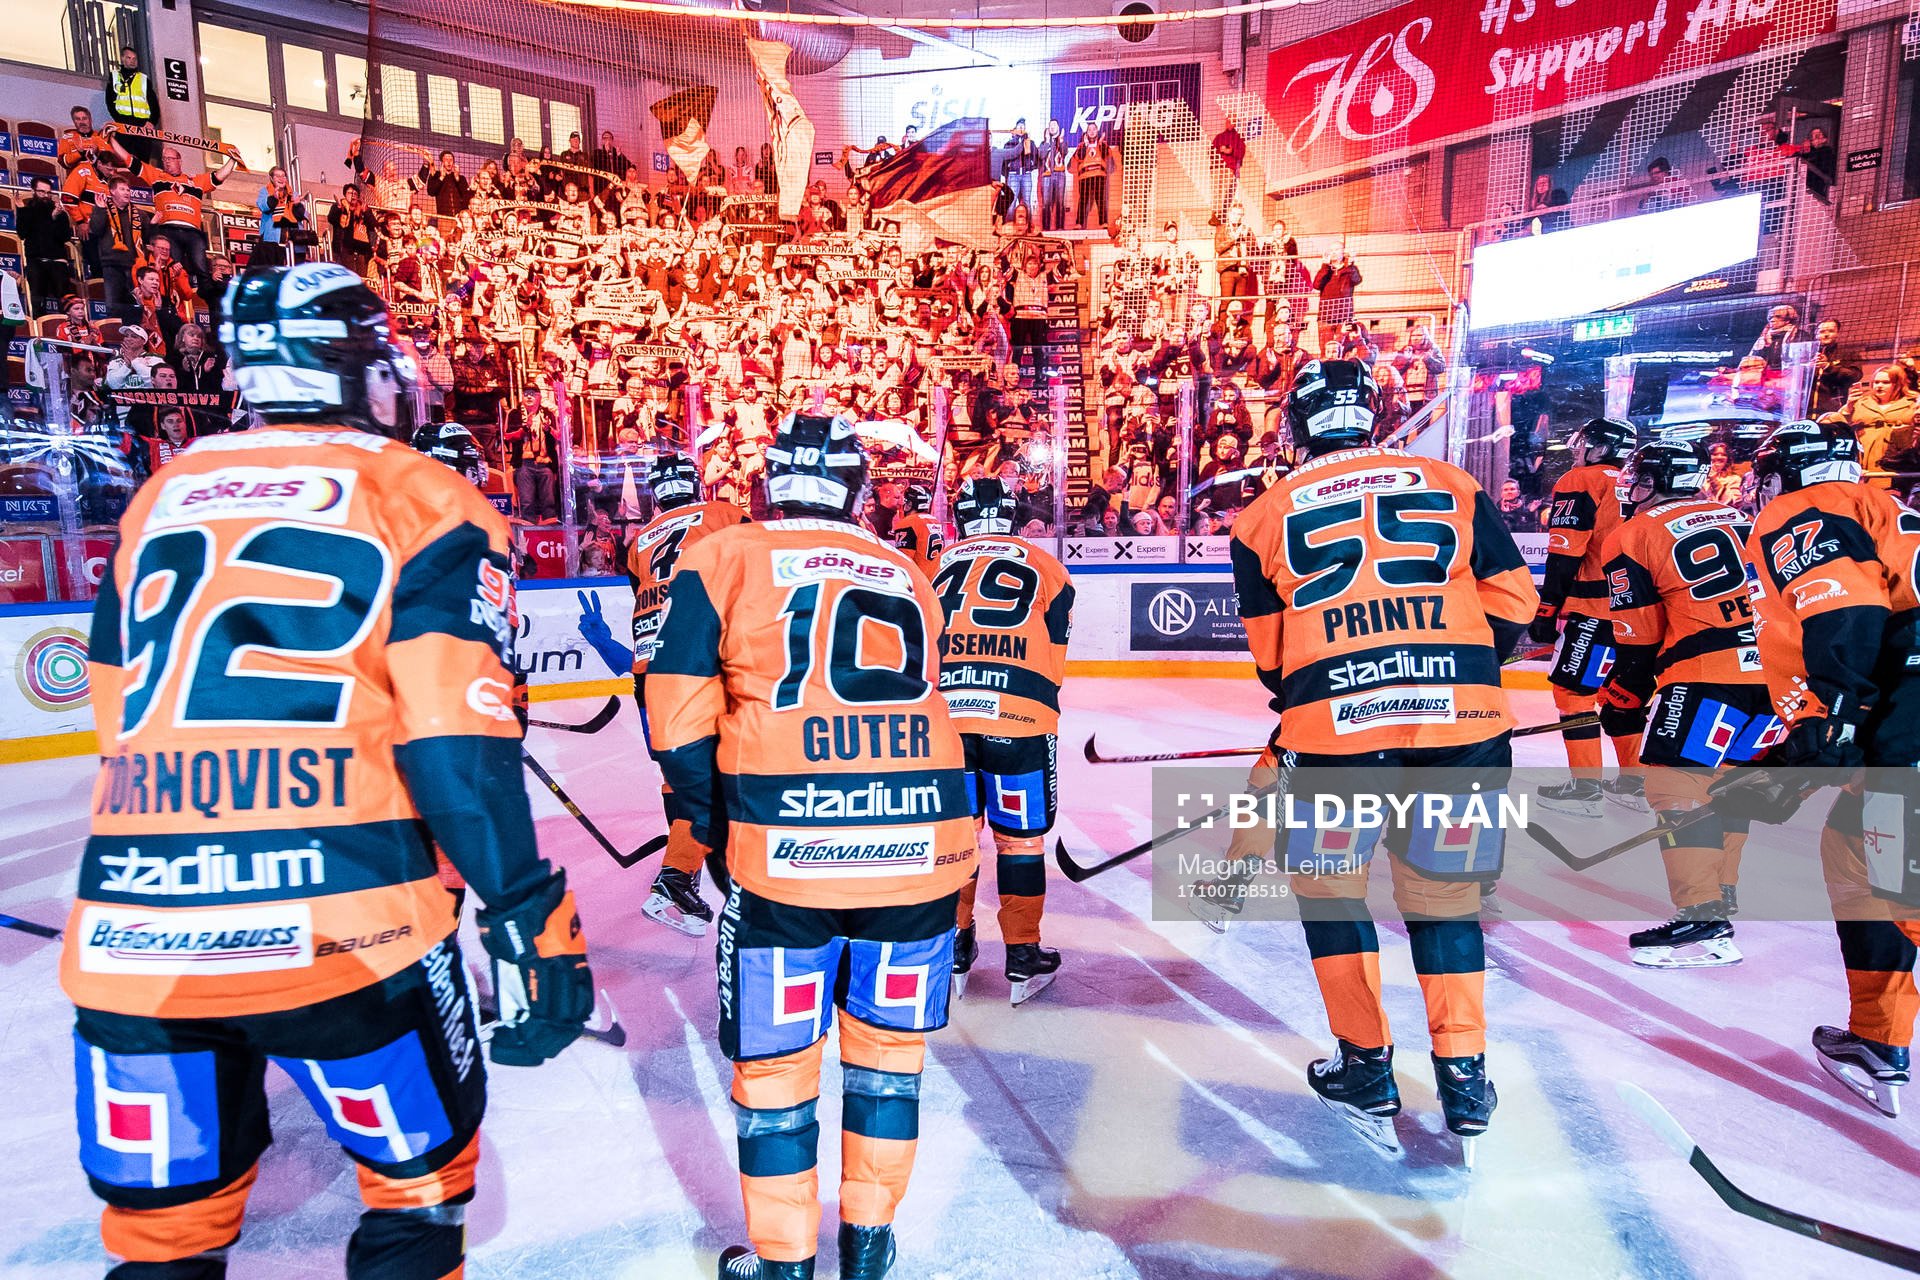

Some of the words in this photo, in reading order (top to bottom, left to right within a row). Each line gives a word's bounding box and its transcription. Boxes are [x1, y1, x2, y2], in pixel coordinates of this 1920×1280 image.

[1484, 0, 1667, 94] Support
[170, 61, 181, 74] C
[22, 138, 55, 150] NKT
[124, 125, 219, 150] KARLSKRONA
[731, 193, 778, 203] KARLSKRO
[788, 245, 854, 255] KARLSKRONA
[388, 302, 437, 314] SKRONA
[238, 324, 277, 351] 92
[1333, 389, 1358, 405] 55
[793, 446, 820, 466] 10
[1834, 438, 1854, 452] 27
[180, 476, 305, 506] BÖRJES
[1317, 474, 1397, 497] BÖRJES
[6, 500, 51, 512] NKT
[979, 507, 999, 519] 49
[1553, 499, 1575, 518] 71
[650, 525, 690, 582] 4
[1136, 545, 1166, 554] Experis
[1283, 490, 1459, 611] 55
[1771, 519, 1824, 575] 27
[1782, 538, 1840, 582] NKT
[804, 553, 896, 579] BÖRJES
[932, 557, 1040, 629] 49
[116, 520, 393, 742] 92
[1323, 595, 1447, 644] PRINTZ
[769, 580, 934, 713] 10
[1562, 632, 1593, 676] Sweden
[940, 665, 1009, 689] adium
[1328, 650, 1456, 690] stadium
[1337, 697, 1450, 721] BERGKVARABUSS
[1656, 685, 1689, 739] Sweden
[803, 714, 931, 762] GUTER
[779, 781, 942, 818] stadium
[772, 838, 930, 861] BERGKVARABUSS
[100, 845, 325, 896] stadium
[89, 920, 300, 951] BERGKVARABUSS
